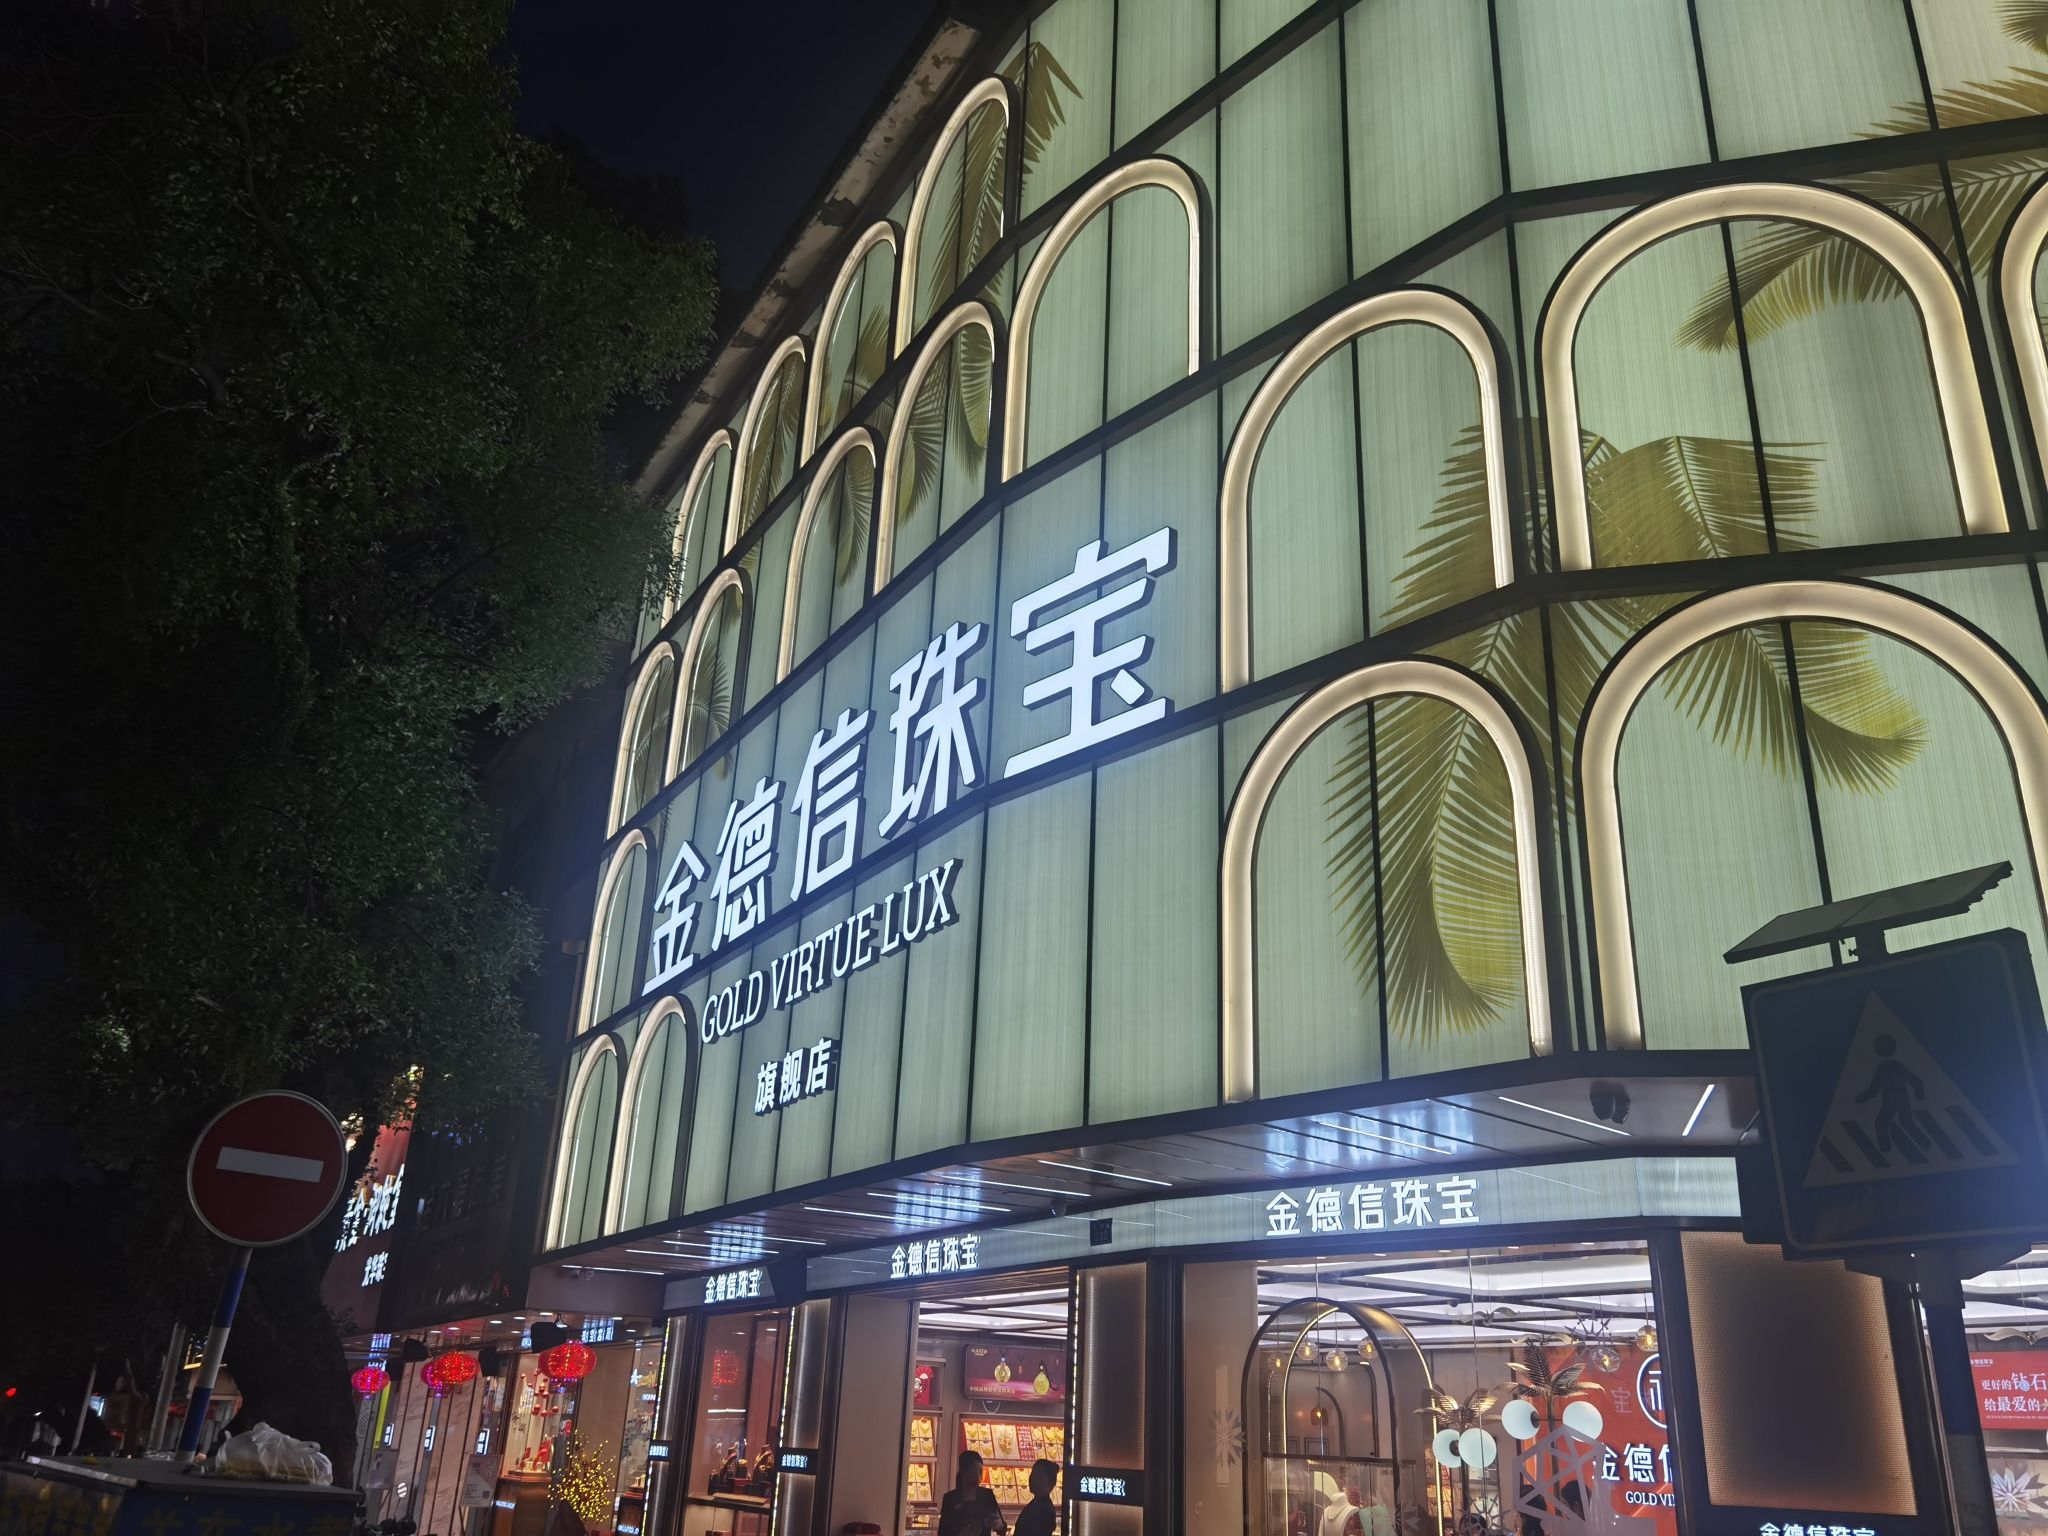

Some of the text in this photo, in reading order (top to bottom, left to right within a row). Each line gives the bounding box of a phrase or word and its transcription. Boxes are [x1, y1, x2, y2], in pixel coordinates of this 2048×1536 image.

[642, 526, 1174, 997] 金德信珠宝
[701, 858, 962, 1043] GOLD VIRTUE LUX
[754, 1037, 837, 1115] 旗舰店
[1265, 1175, 1480, 1237] 金德信珠宝
[890, 1233, 980, 1279] 金德信珠宝
[704, 1268, 762, 1304] 金德信珠宝
[1981, 1372, 2047, 1392] 更好的钻石
[1080, 1476, 1126, 1496] 金德信珠宝
[1625, 1491, 1676, 1507] GOLD VI
